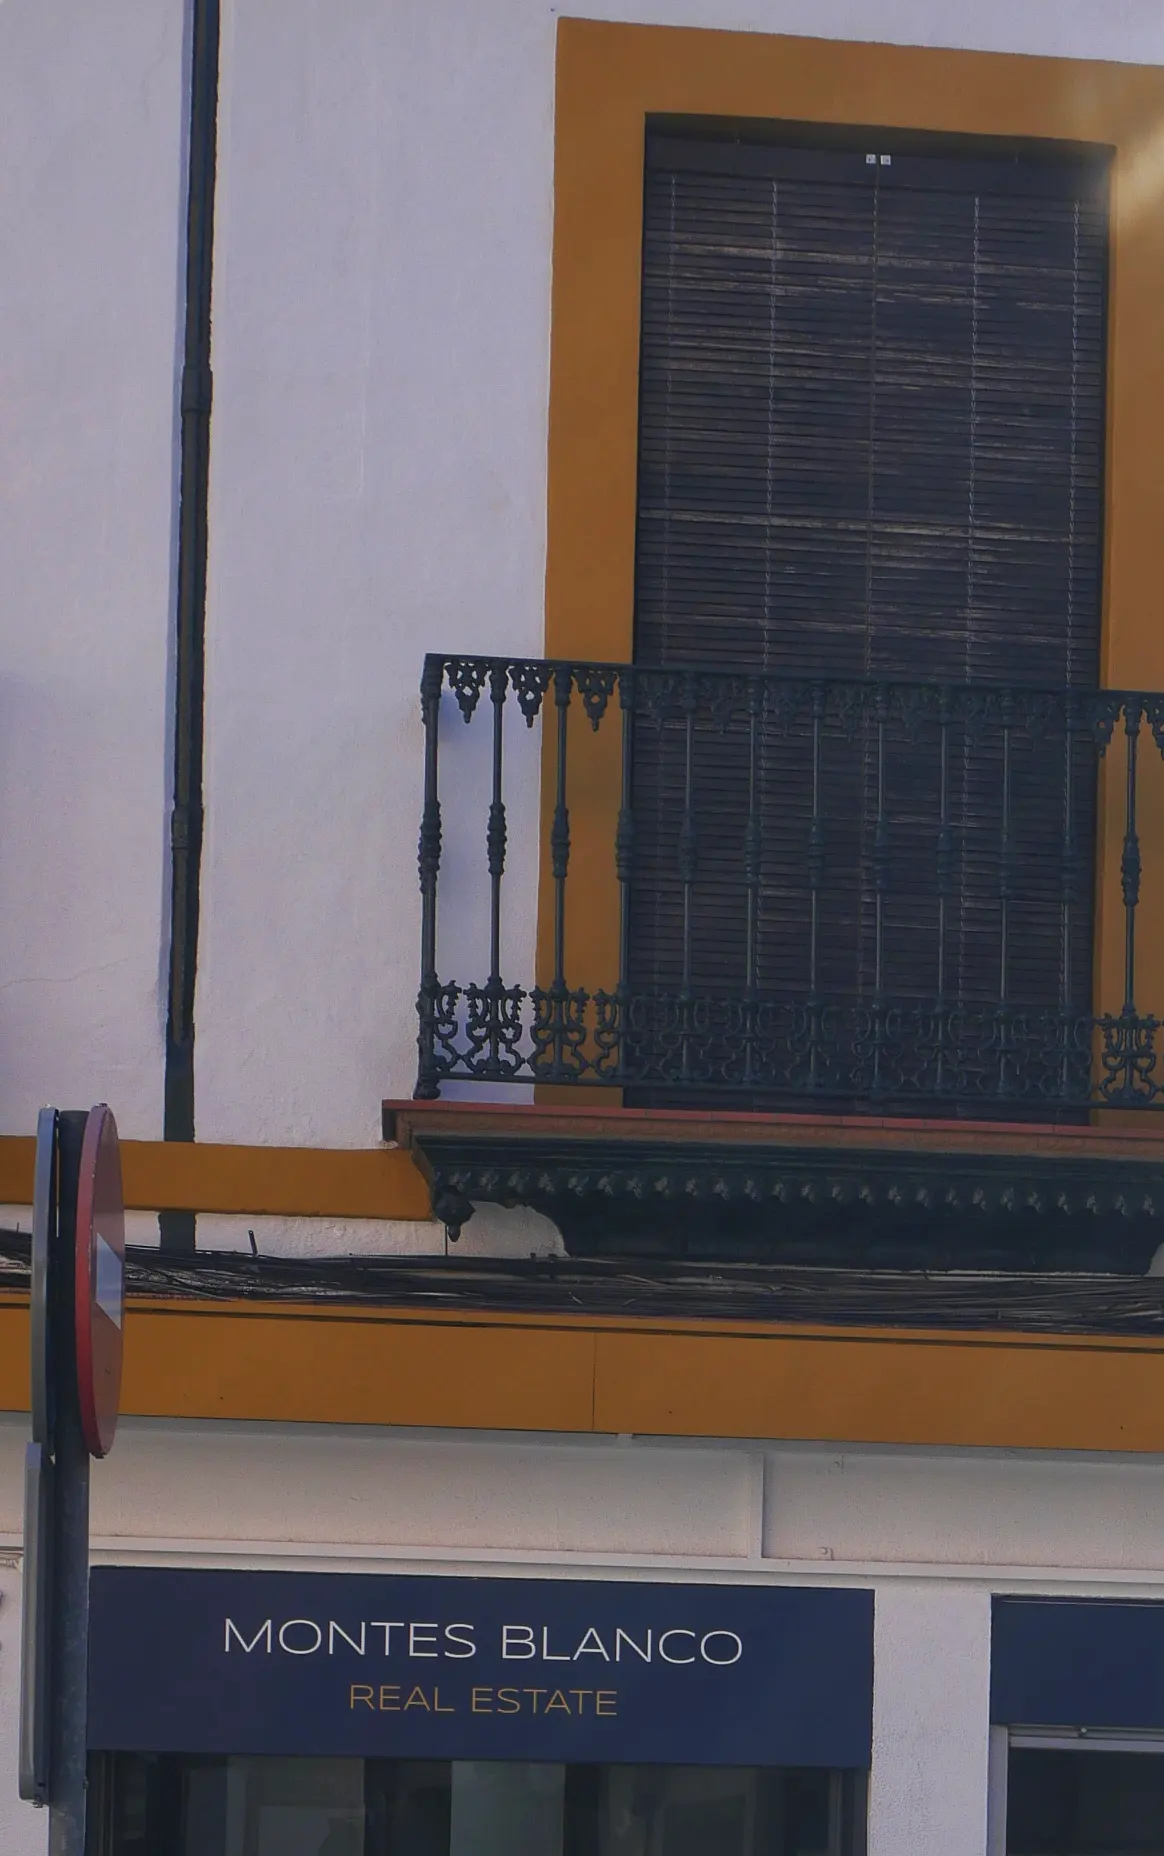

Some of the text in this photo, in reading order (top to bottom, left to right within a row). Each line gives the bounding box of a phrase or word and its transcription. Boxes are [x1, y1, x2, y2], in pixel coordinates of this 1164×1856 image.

[224, 1617, 743, 1665] MONTES BLANCO
[349, 1684, 618, 1716] REAL ESTATE
